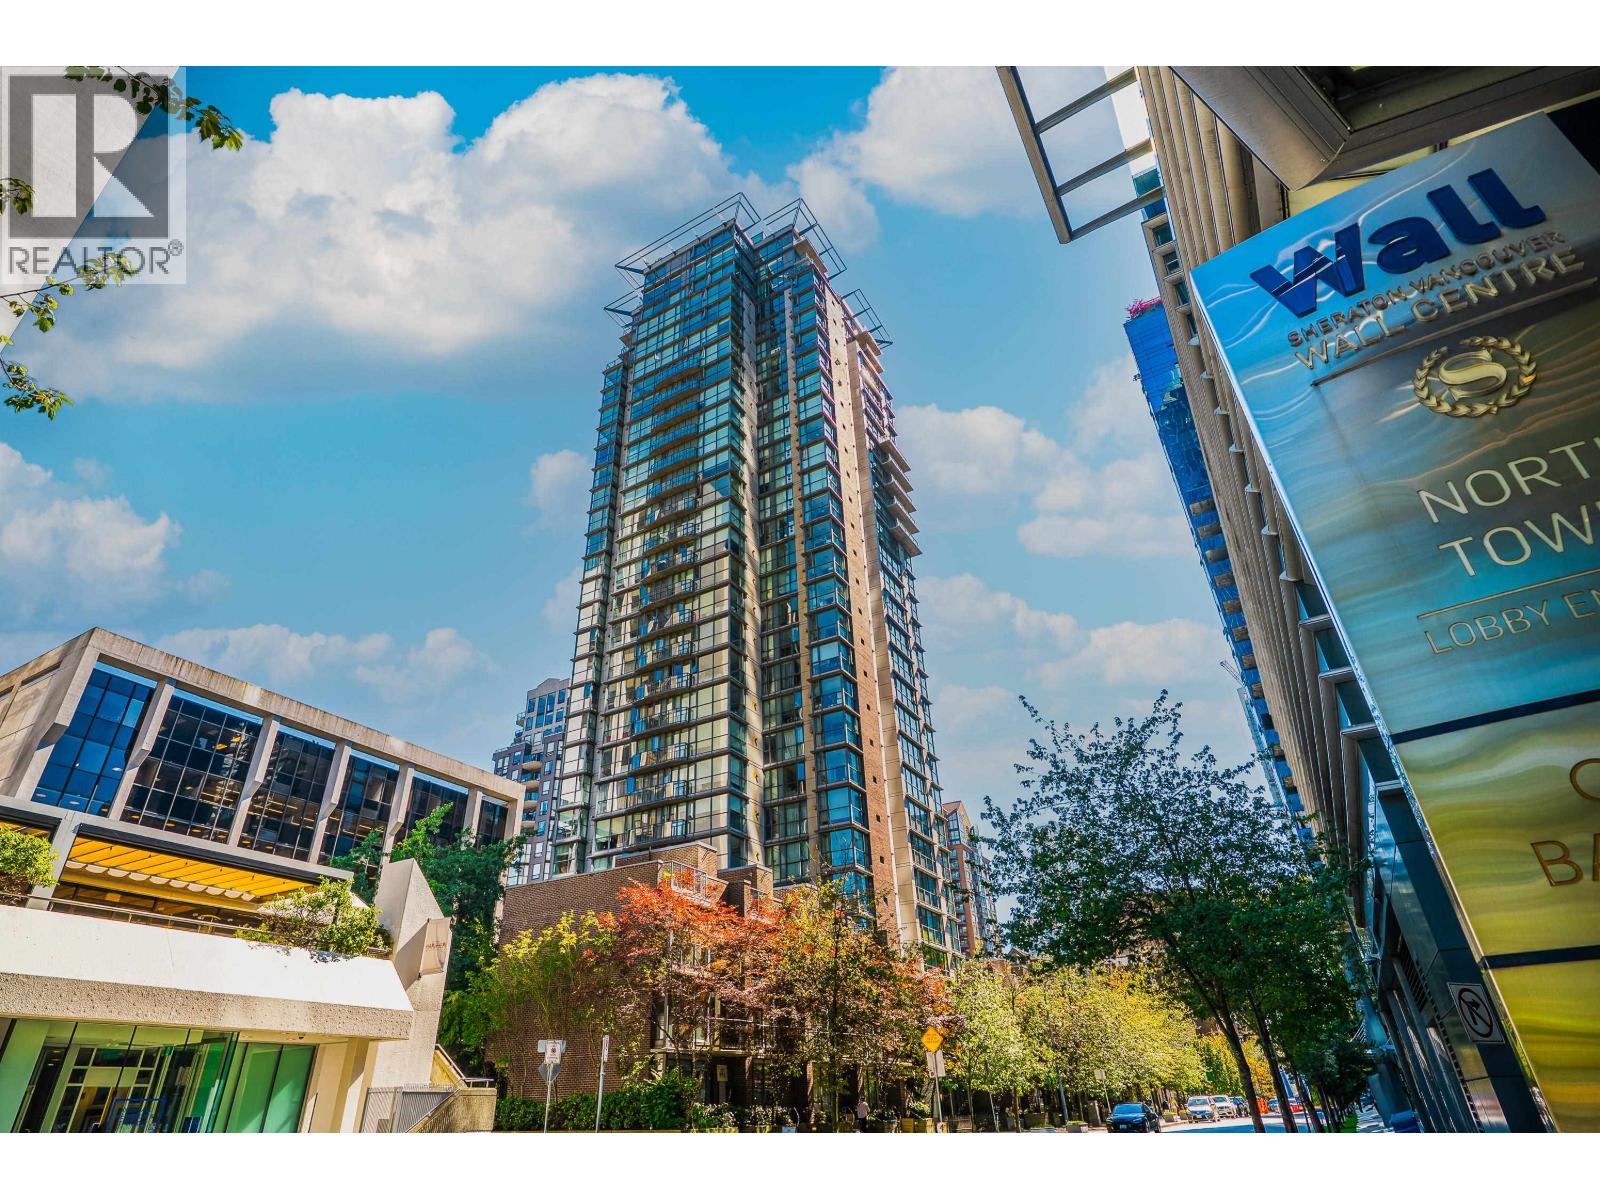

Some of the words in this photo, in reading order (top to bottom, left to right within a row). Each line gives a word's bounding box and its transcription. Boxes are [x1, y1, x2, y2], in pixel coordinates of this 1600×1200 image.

[1249, 168, 1547, 318] Wall
[1287, 286, 1408, 347] SHERATON
[1409, 231, 1566, 294] VANCOUVER
[1295, 312, 1406, 370] WALL
[1411, 247, 1585, 322] CENTRE
[1417, 436, 1600, 523] NORT
[1437, 502, 1600, 577] TOW
[1424, 599, 1551, 654] LOBBY
